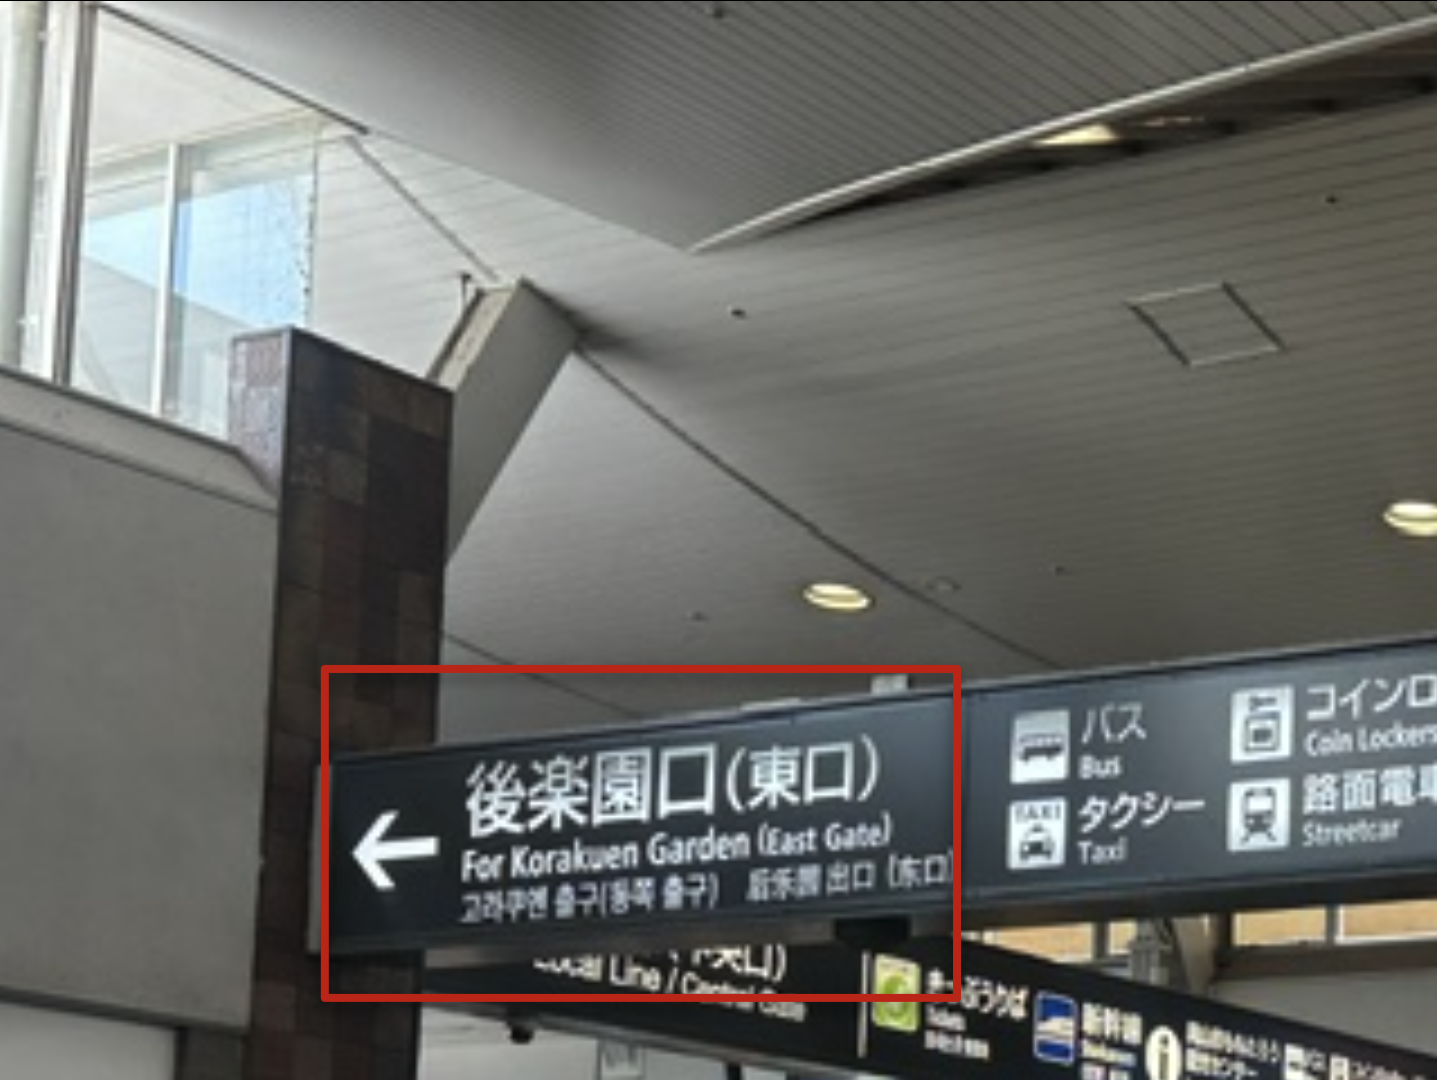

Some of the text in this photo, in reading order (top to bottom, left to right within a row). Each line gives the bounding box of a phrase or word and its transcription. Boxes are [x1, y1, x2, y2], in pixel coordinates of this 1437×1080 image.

[1081, 703, 1147, 744] バス
[1305, 730, 1354, 757] Coin
[1078, 755, 1123, 779] Bus
[464, 734, 883, 839] 後楽園口(東口)
[1077, 791, 1206, 833] タクシー
[460, 812, 893, 883] For Korakuen Garden (East Gate)
[1301, 818, 1402, 848] Streetcar
[1078, 838, 1127, 866] Taxi
